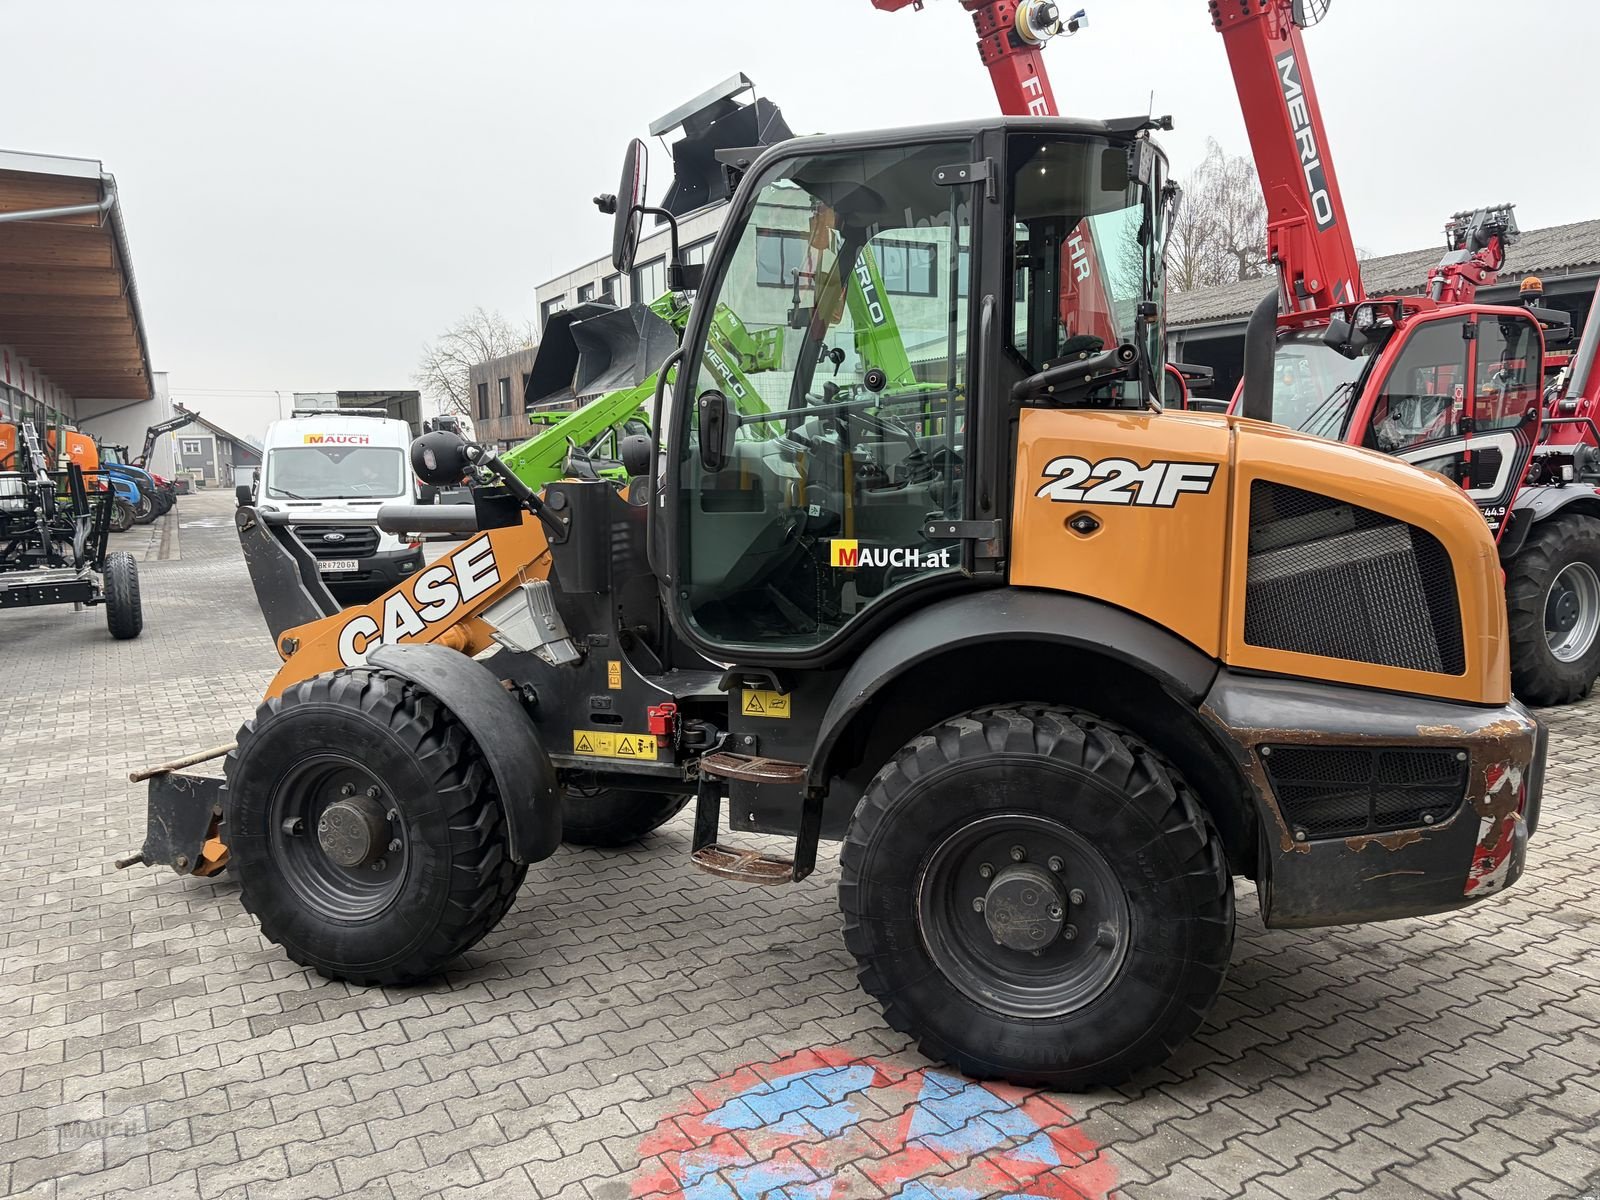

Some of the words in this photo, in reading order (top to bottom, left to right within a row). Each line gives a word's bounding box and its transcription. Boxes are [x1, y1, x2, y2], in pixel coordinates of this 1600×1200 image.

[1022, 76, 1049, 116] FE
[1068, 230, 1092, 283] HR
[1277, 55, 1333, 226] MERLO
[309, 436, 369, 444] MAUCH
[1034, 456, 1219, 508] 221F
[338, 532, 501, 668] CASE
[838, 548, 950, 568] MAUCH.at
